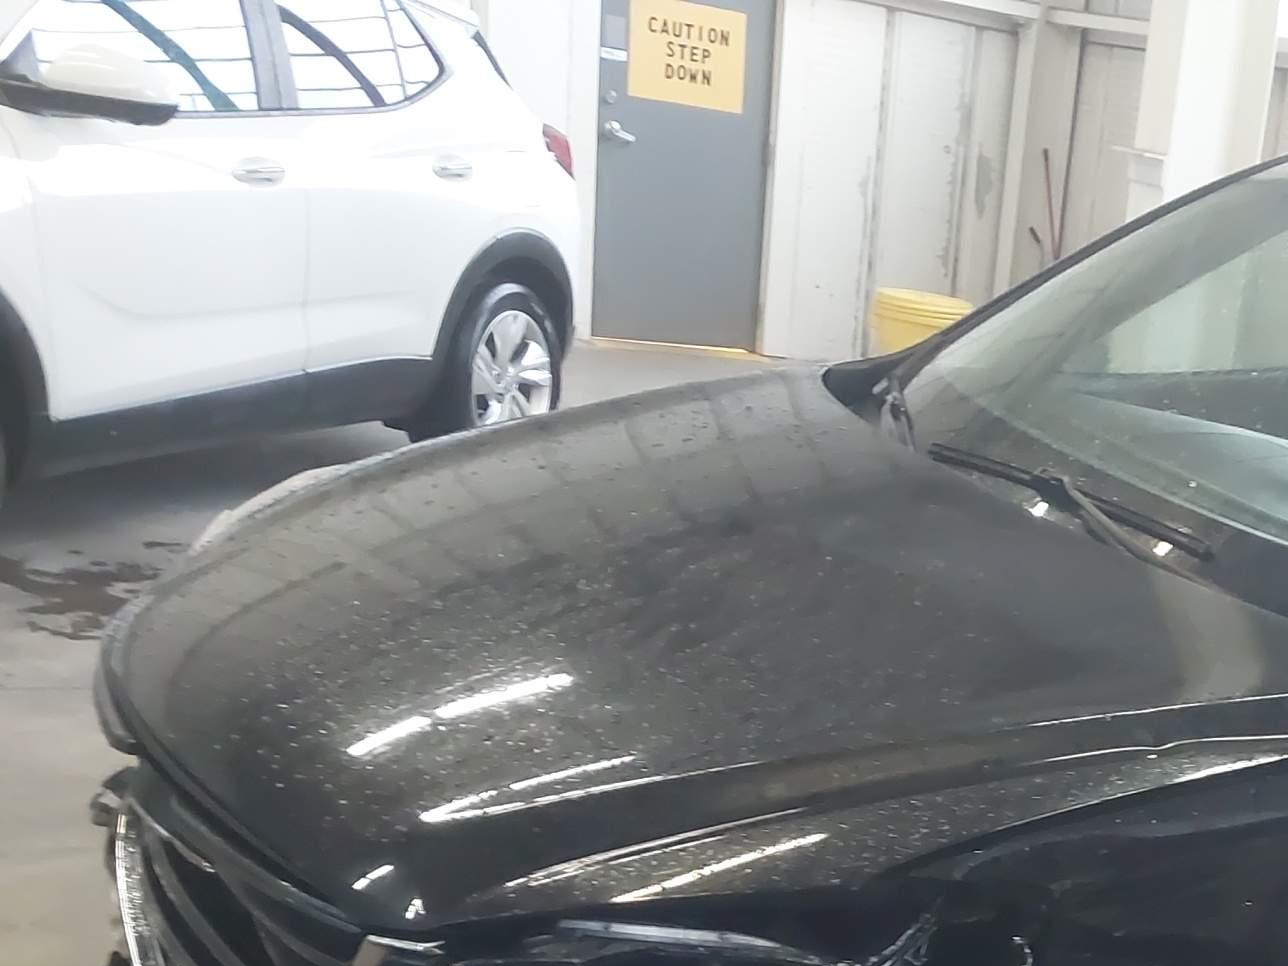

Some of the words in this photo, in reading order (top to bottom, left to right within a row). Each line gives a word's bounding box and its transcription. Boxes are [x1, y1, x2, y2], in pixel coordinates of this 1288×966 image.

[648, 17, 730, 46] CAUTION
[666, 41, 712, 64] STEP
[665, 64, 712, 85] DOWN
